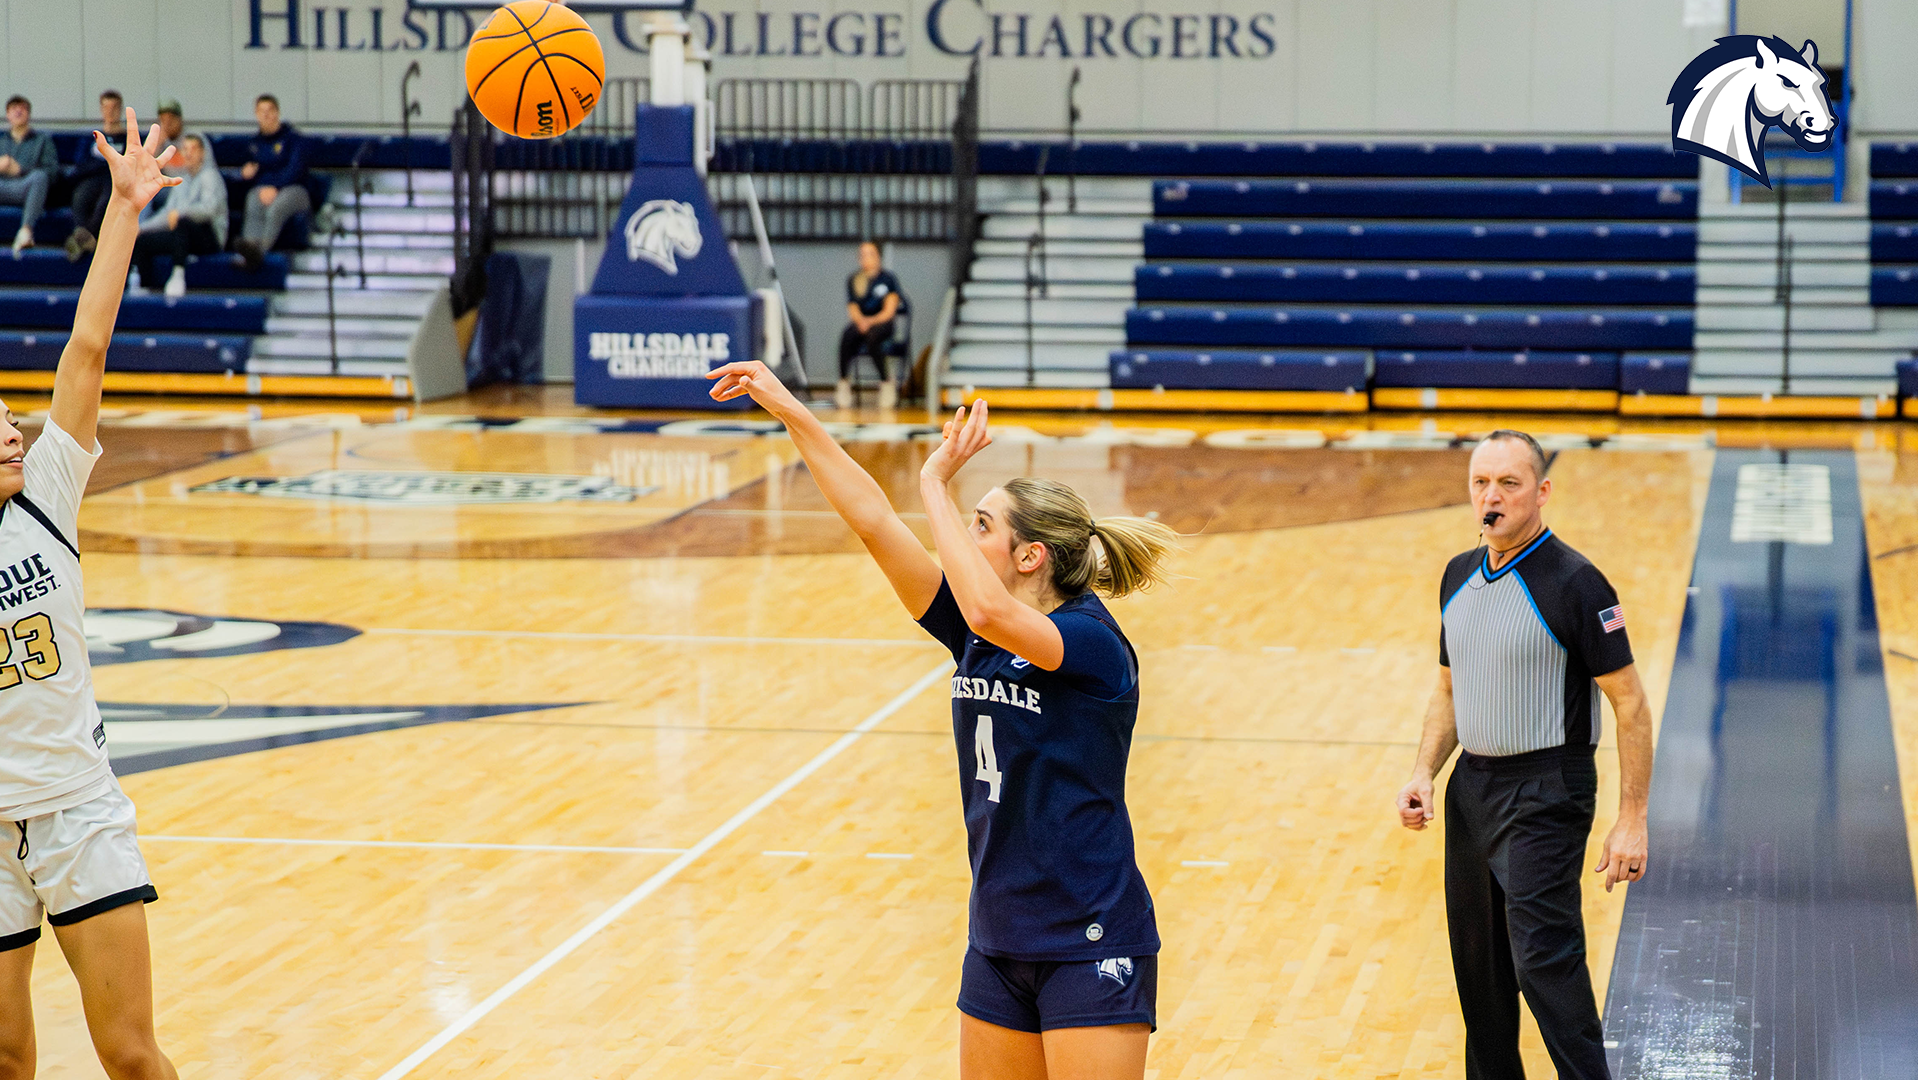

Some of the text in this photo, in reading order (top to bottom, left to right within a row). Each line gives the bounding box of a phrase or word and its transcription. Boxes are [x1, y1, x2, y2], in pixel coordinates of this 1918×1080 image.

[244, 0, 475, 51] HILLSD
[925, 0, 1276, 58] CHARGERS
[531, 100, 554, 138] lson
[589, 332, 730, 359] HILLSDALE
[607, 355, 711, 379] CHARGERS
[975, 714, 1002, 803] 4
